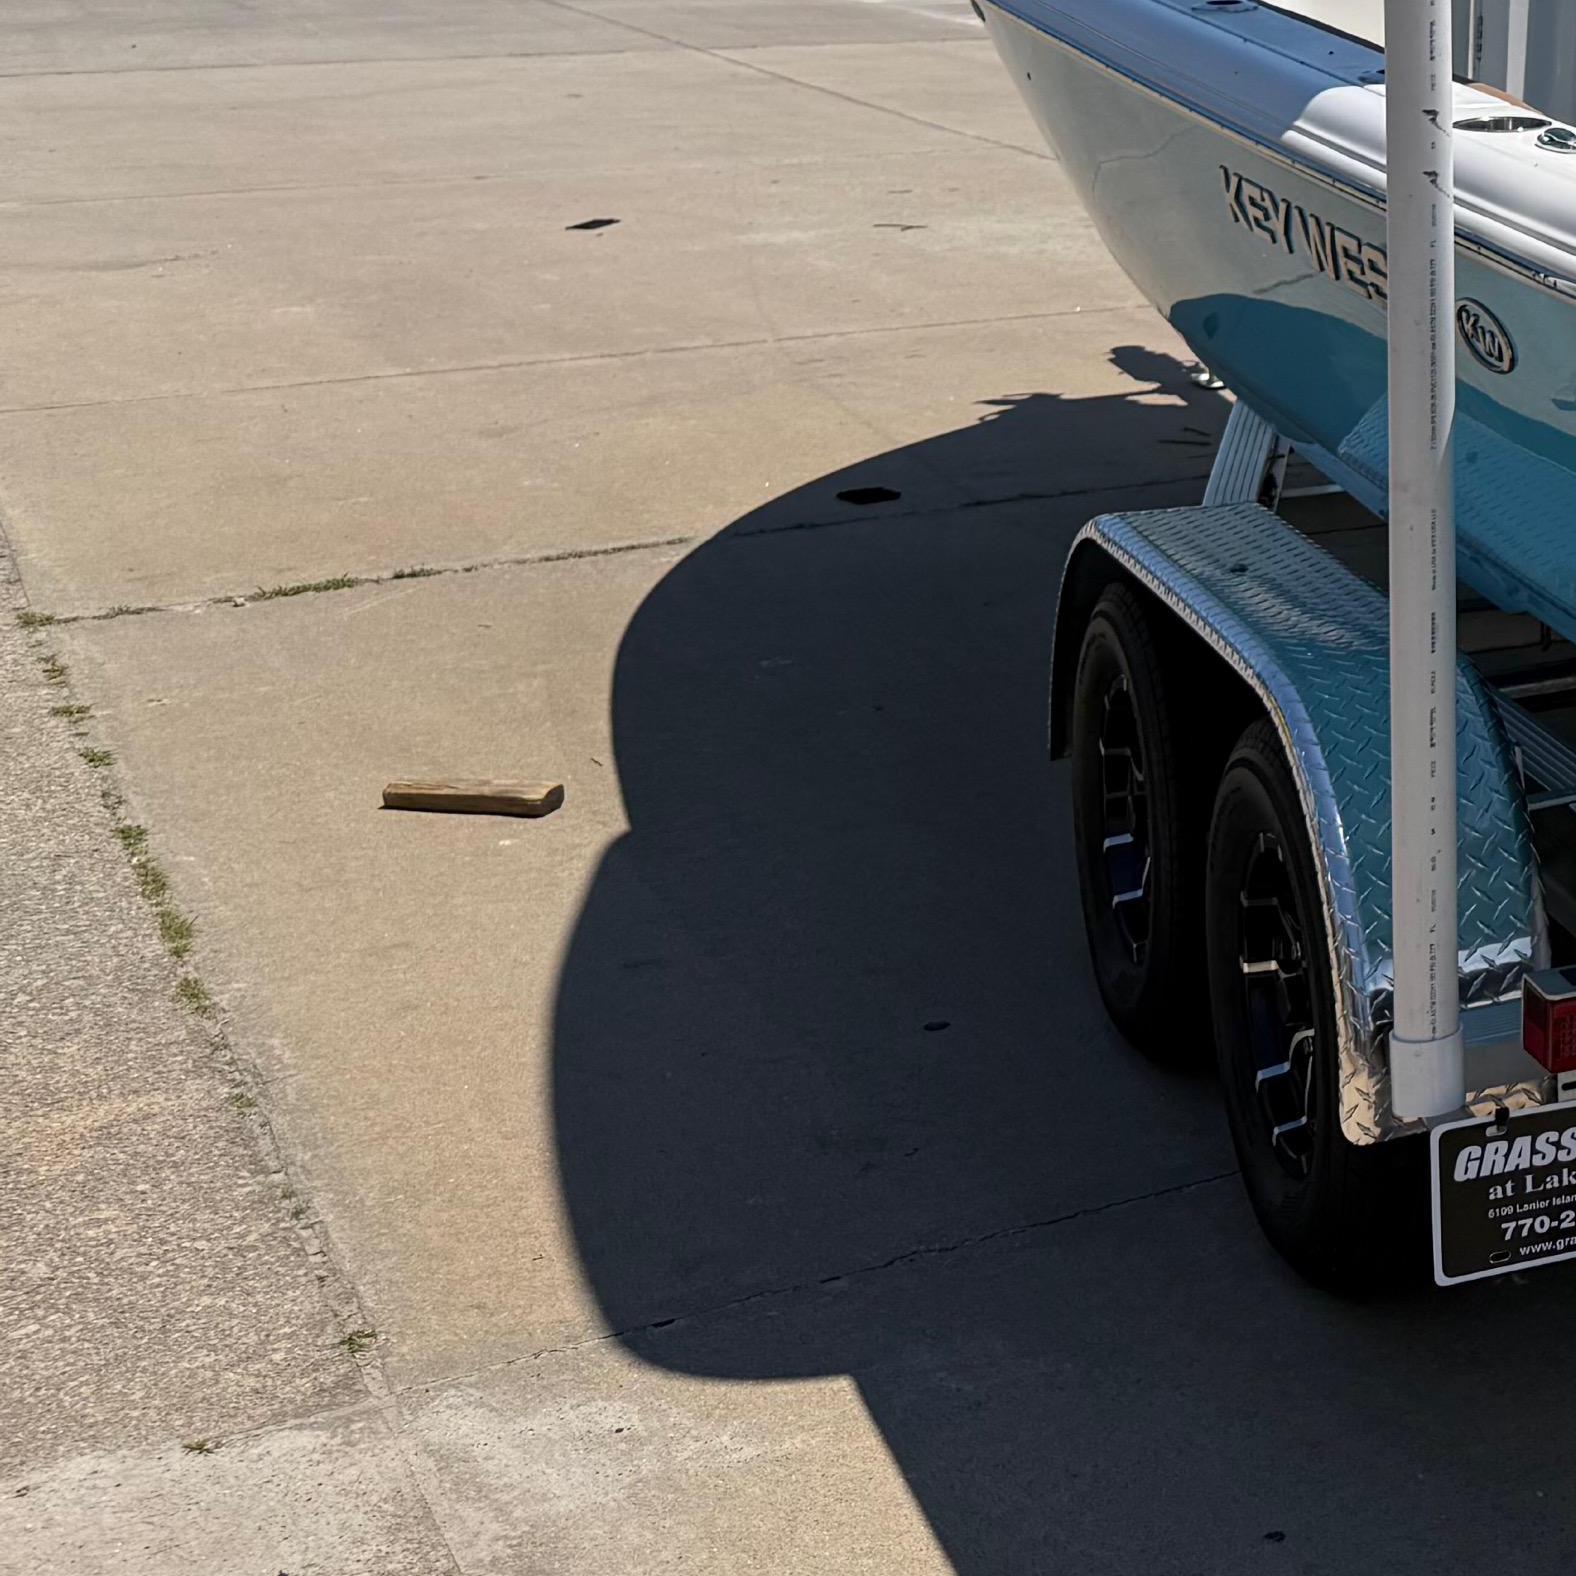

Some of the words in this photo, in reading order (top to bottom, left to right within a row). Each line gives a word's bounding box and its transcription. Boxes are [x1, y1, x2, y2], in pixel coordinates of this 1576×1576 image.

[1219, 165, 1294, 254] KEY
[1295, 205, 1387, 309] WES
[1461, 309, 1504, 363] KW
[1489, 1181, 1515, 1200] at
[1516, 1198, 1550, 1214] Lanier
